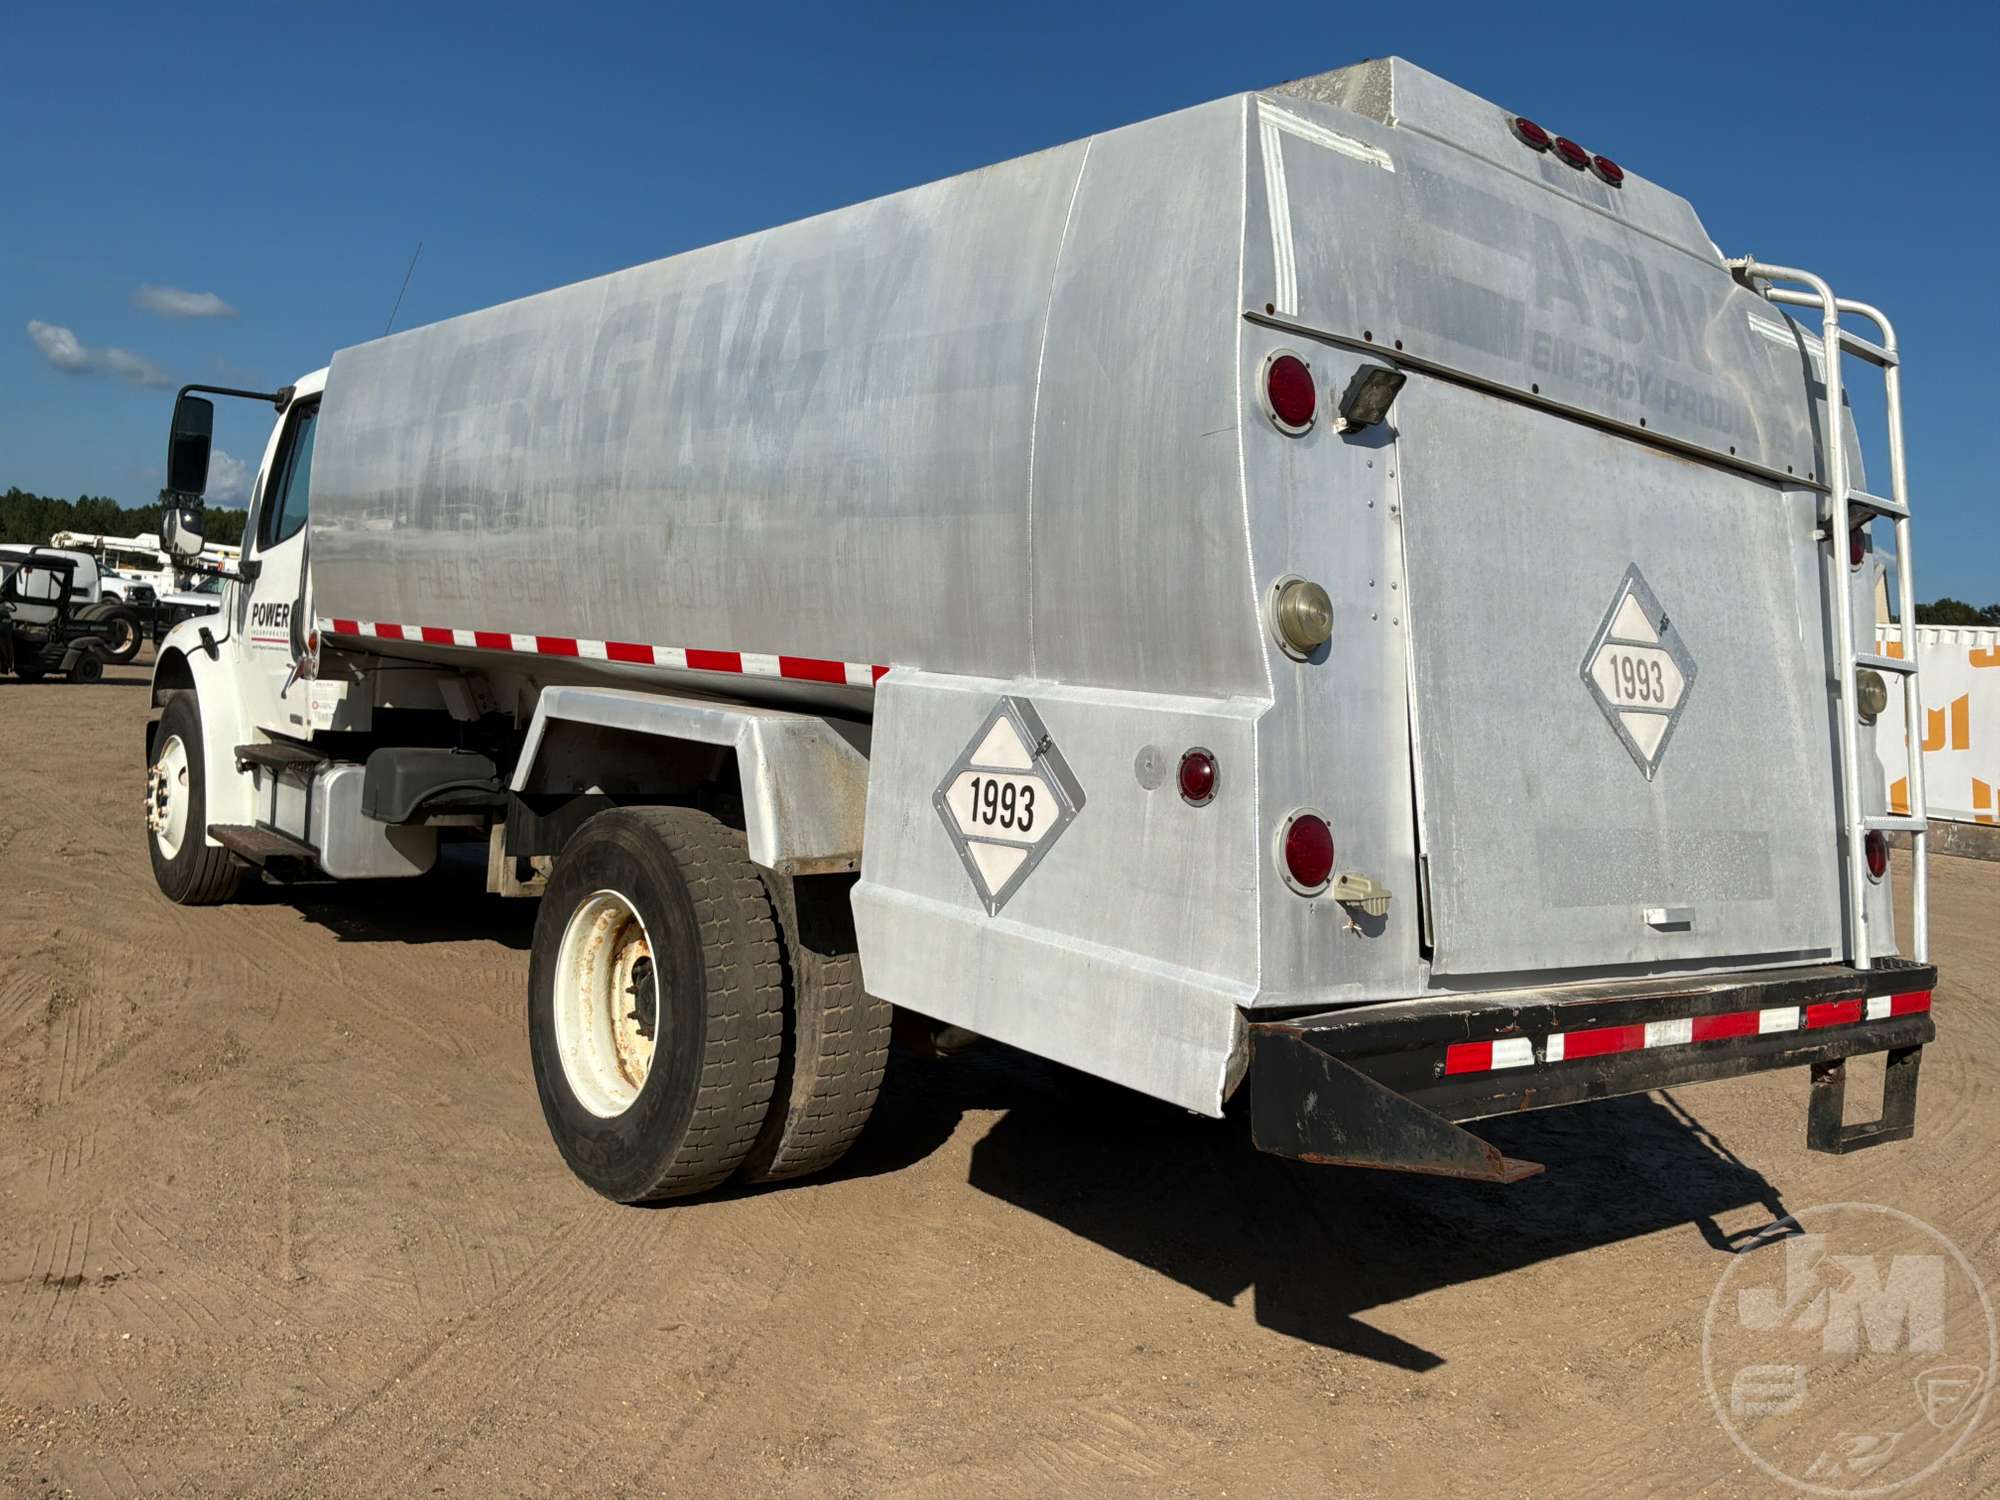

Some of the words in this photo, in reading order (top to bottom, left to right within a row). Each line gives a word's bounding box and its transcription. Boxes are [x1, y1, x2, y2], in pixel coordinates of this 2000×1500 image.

[251, 603, 290, 628] POWER
[1610, 653, 1665, 703] 1993
[970, 776, 1036, 833] 1993
